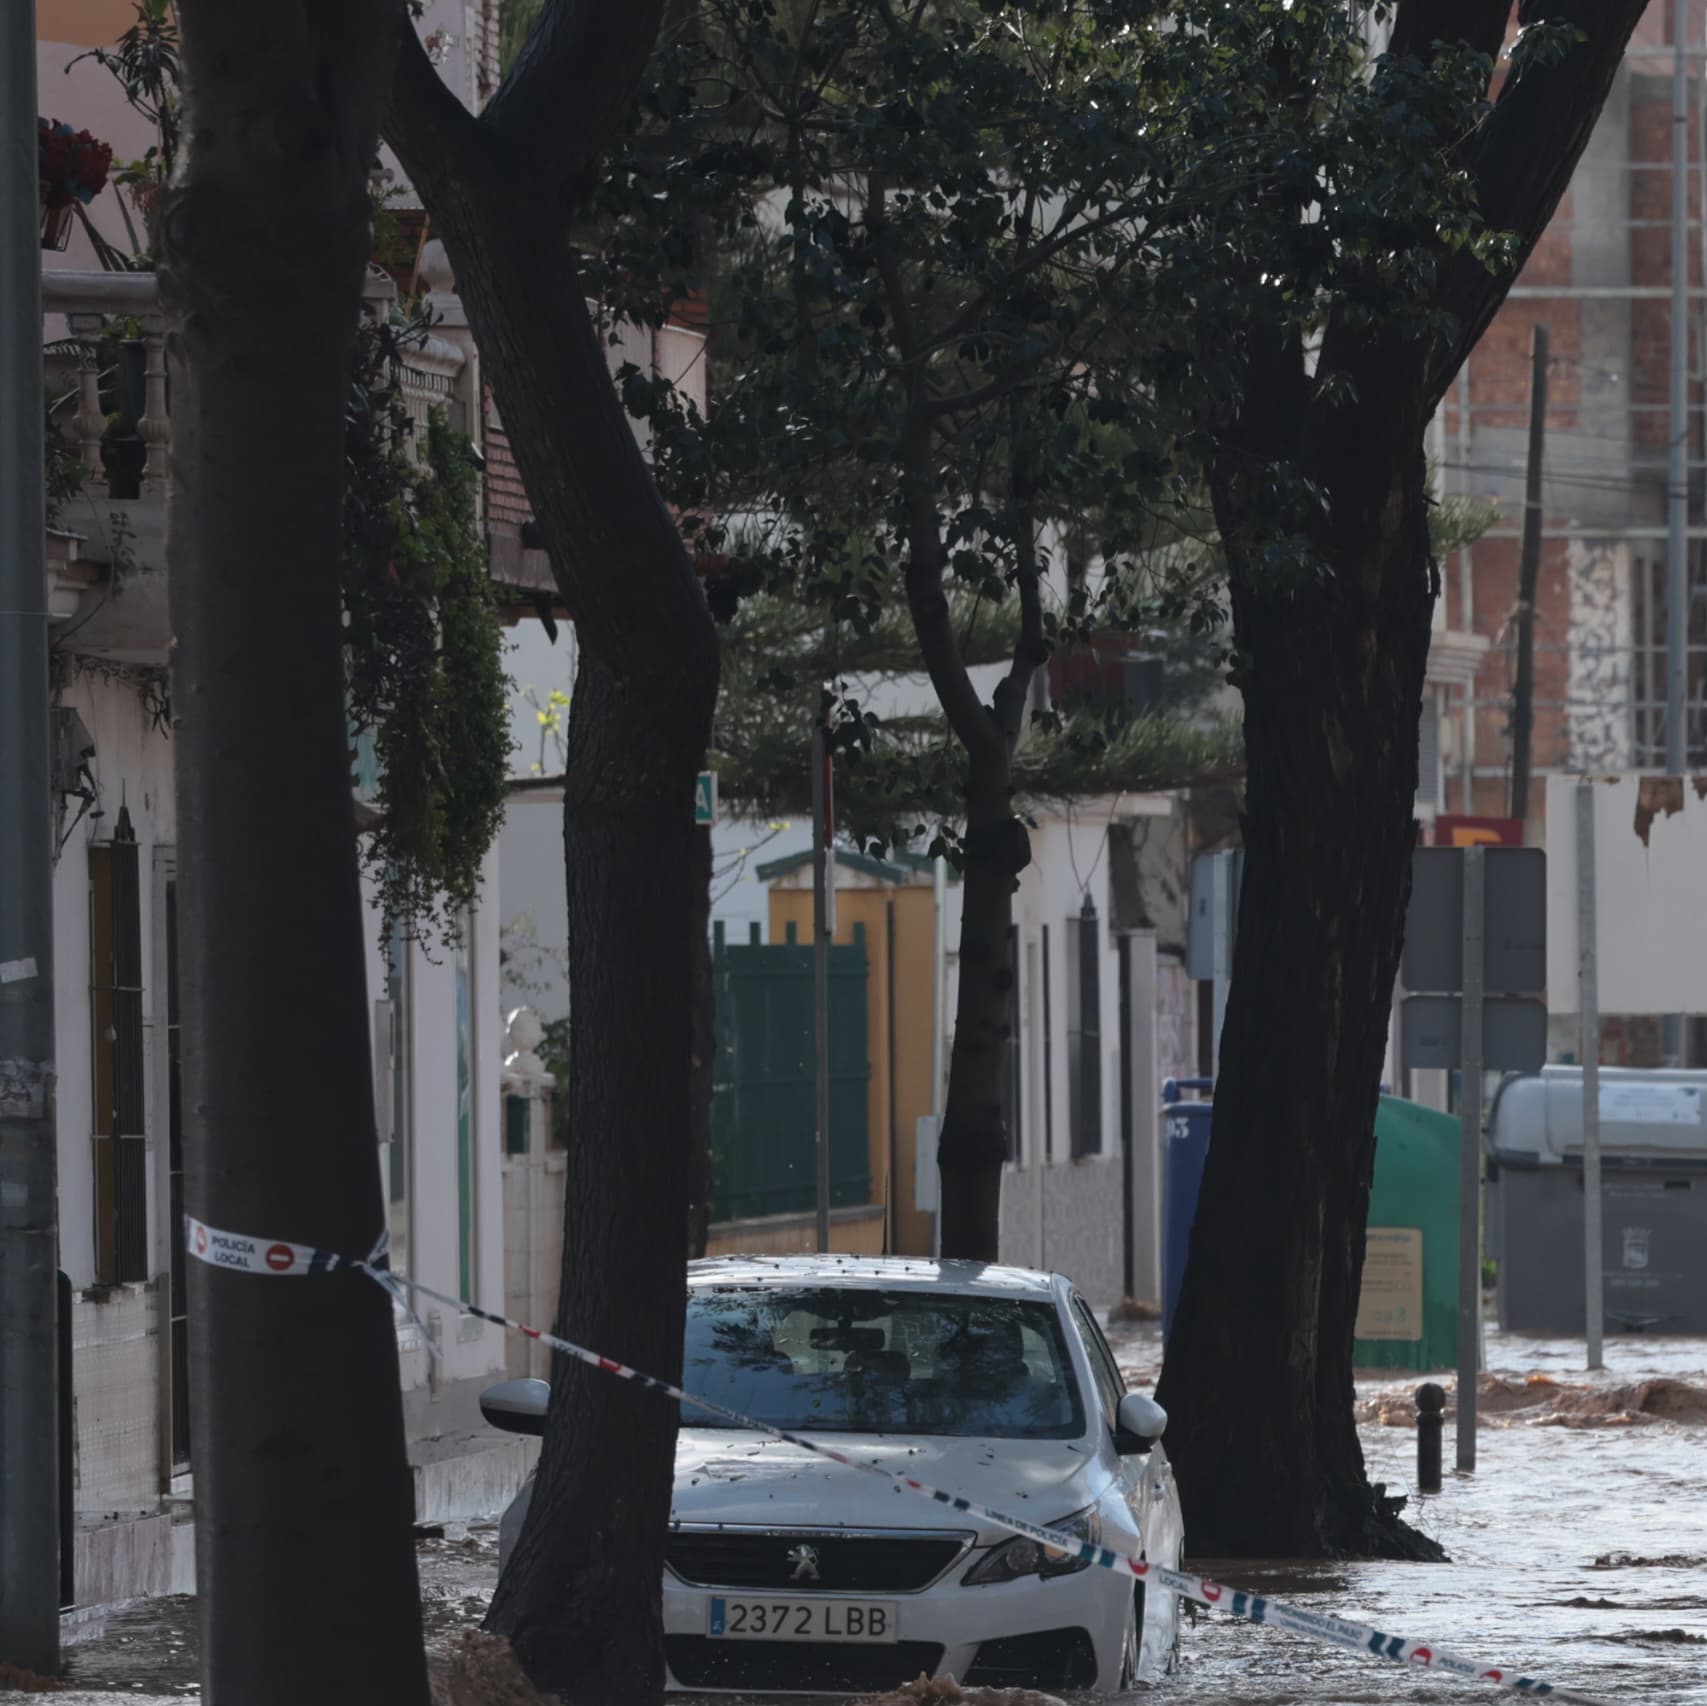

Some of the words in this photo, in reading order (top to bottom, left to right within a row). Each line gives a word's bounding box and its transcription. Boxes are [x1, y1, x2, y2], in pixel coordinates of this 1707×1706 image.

[215, 1252, 250, 1268] LOCAL
[729, 1603, 812, 1635] 2372
[825, 1606, 886, 1636] LBB
